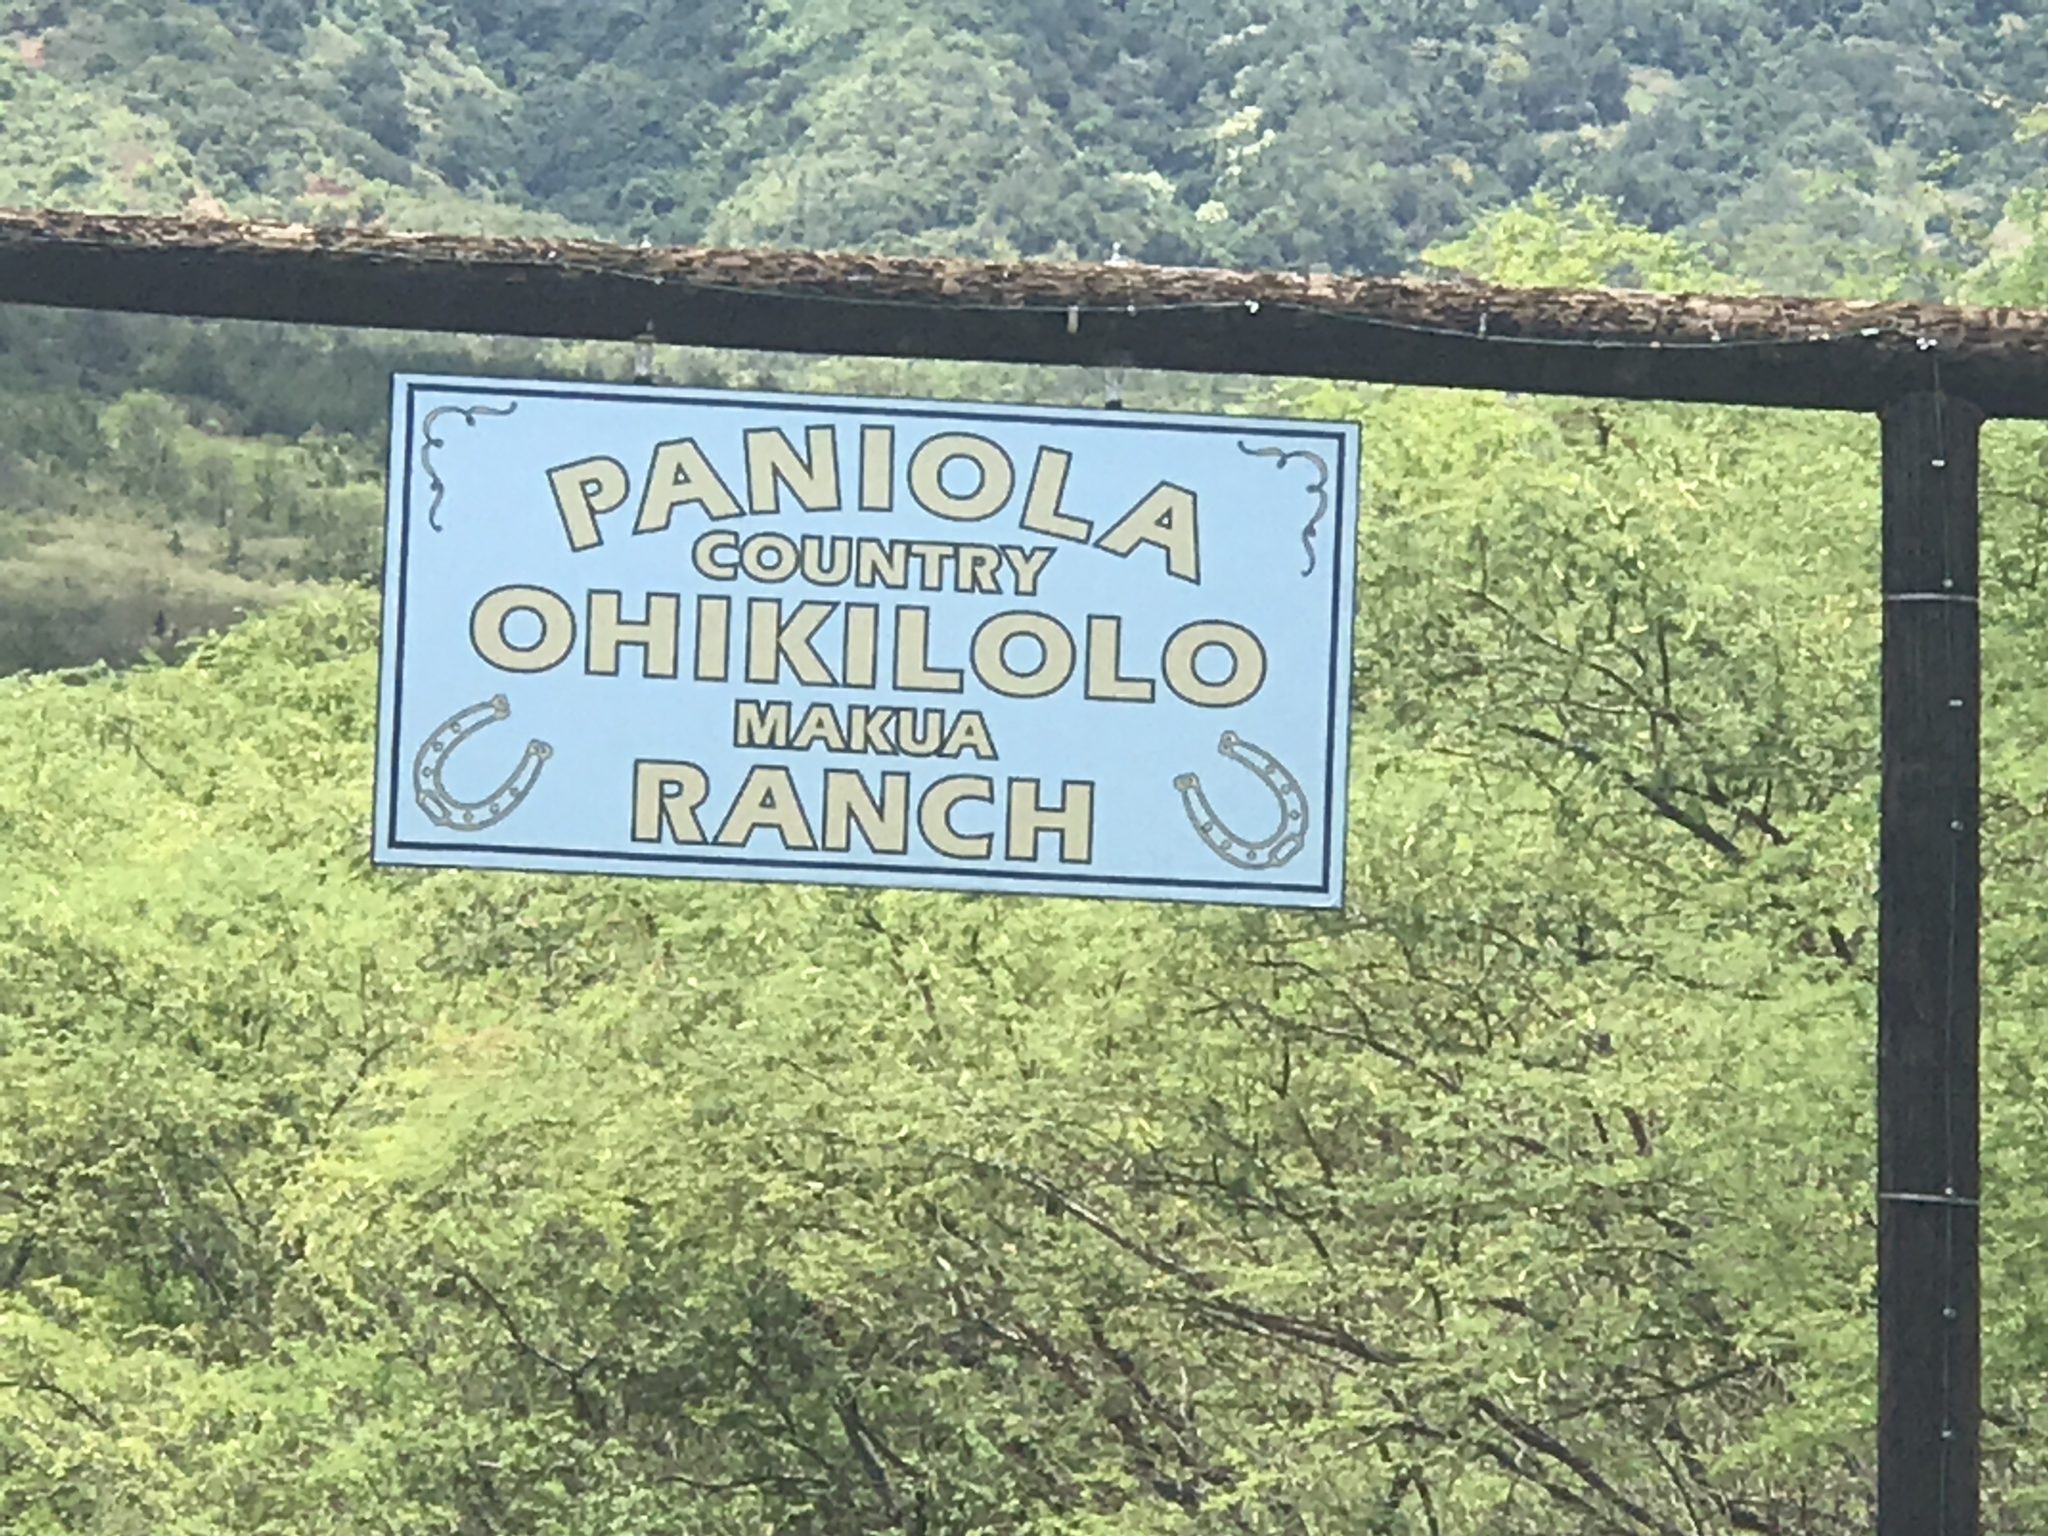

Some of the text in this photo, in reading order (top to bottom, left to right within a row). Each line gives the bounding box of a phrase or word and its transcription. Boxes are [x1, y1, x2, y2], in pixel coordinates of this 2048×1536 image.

[547, 425, 1201, 585] PANIOLA
[692, 530, 1055, 595] COUNTRY
[470, 584, 1268, 707] OHIKILOLO
[734, 699, 998, 761] MAKUA
[631, 758, 1094, 864] RANCH
